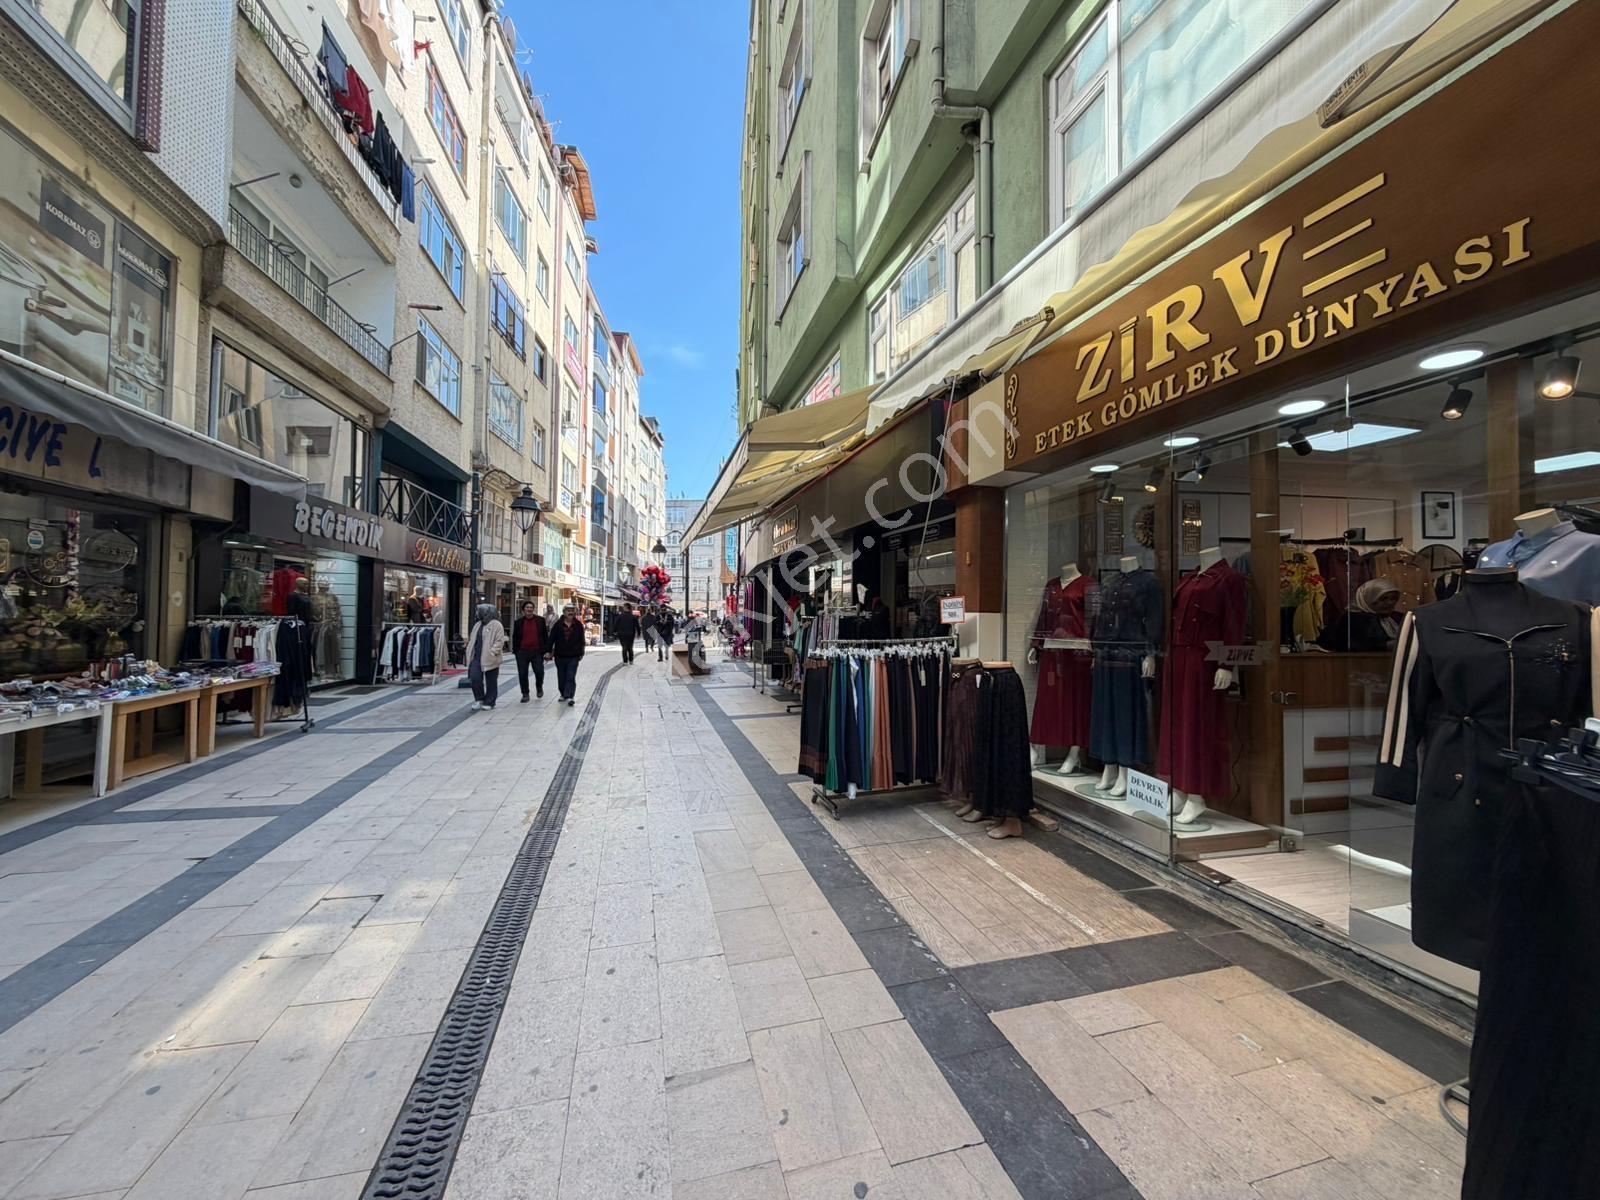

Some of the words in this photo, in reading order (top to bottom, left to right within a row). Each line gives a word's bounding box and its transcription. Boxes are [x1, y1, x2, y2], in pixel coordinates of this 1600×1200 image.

[45, 201, 87, 237] KORKMAZ
[1035, 411, 1093, 453] ETEK
[1101, 347, 1239, 426] GÖMLEK
[1255, 217, 1531, 366] DÜNYASI
[294, 501, 384, 552] BEĞENDİK
[1130, 787, 1164, 809] KİRALIK
[1131, 775, 1164, 796] DEVREN
